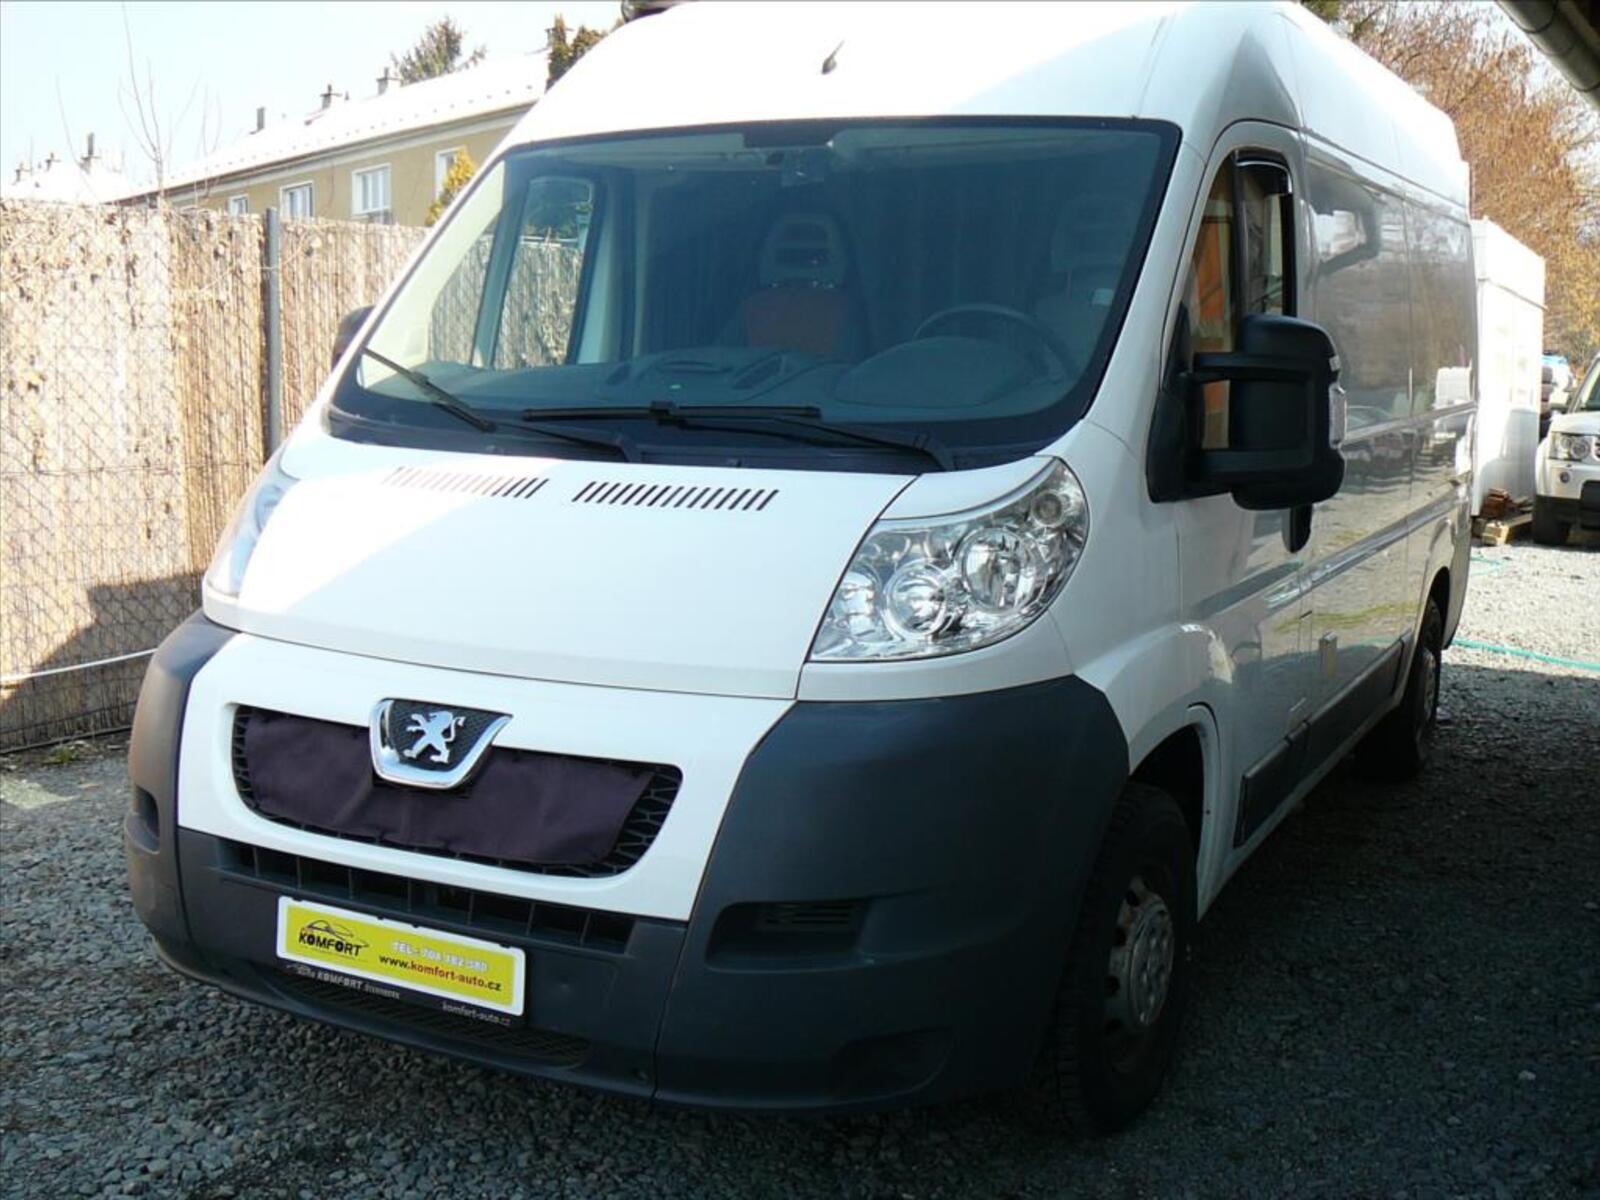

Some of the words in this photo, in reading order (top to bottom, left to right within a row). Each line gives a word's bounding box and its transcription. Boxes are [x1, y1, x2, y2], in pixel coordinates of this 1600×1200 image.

[298, 931, 362, 957] KOMFORT
[316, 970, 362, 990] KOMFORT
[379, 953, 502, 992] www.komfort-auto.cz
